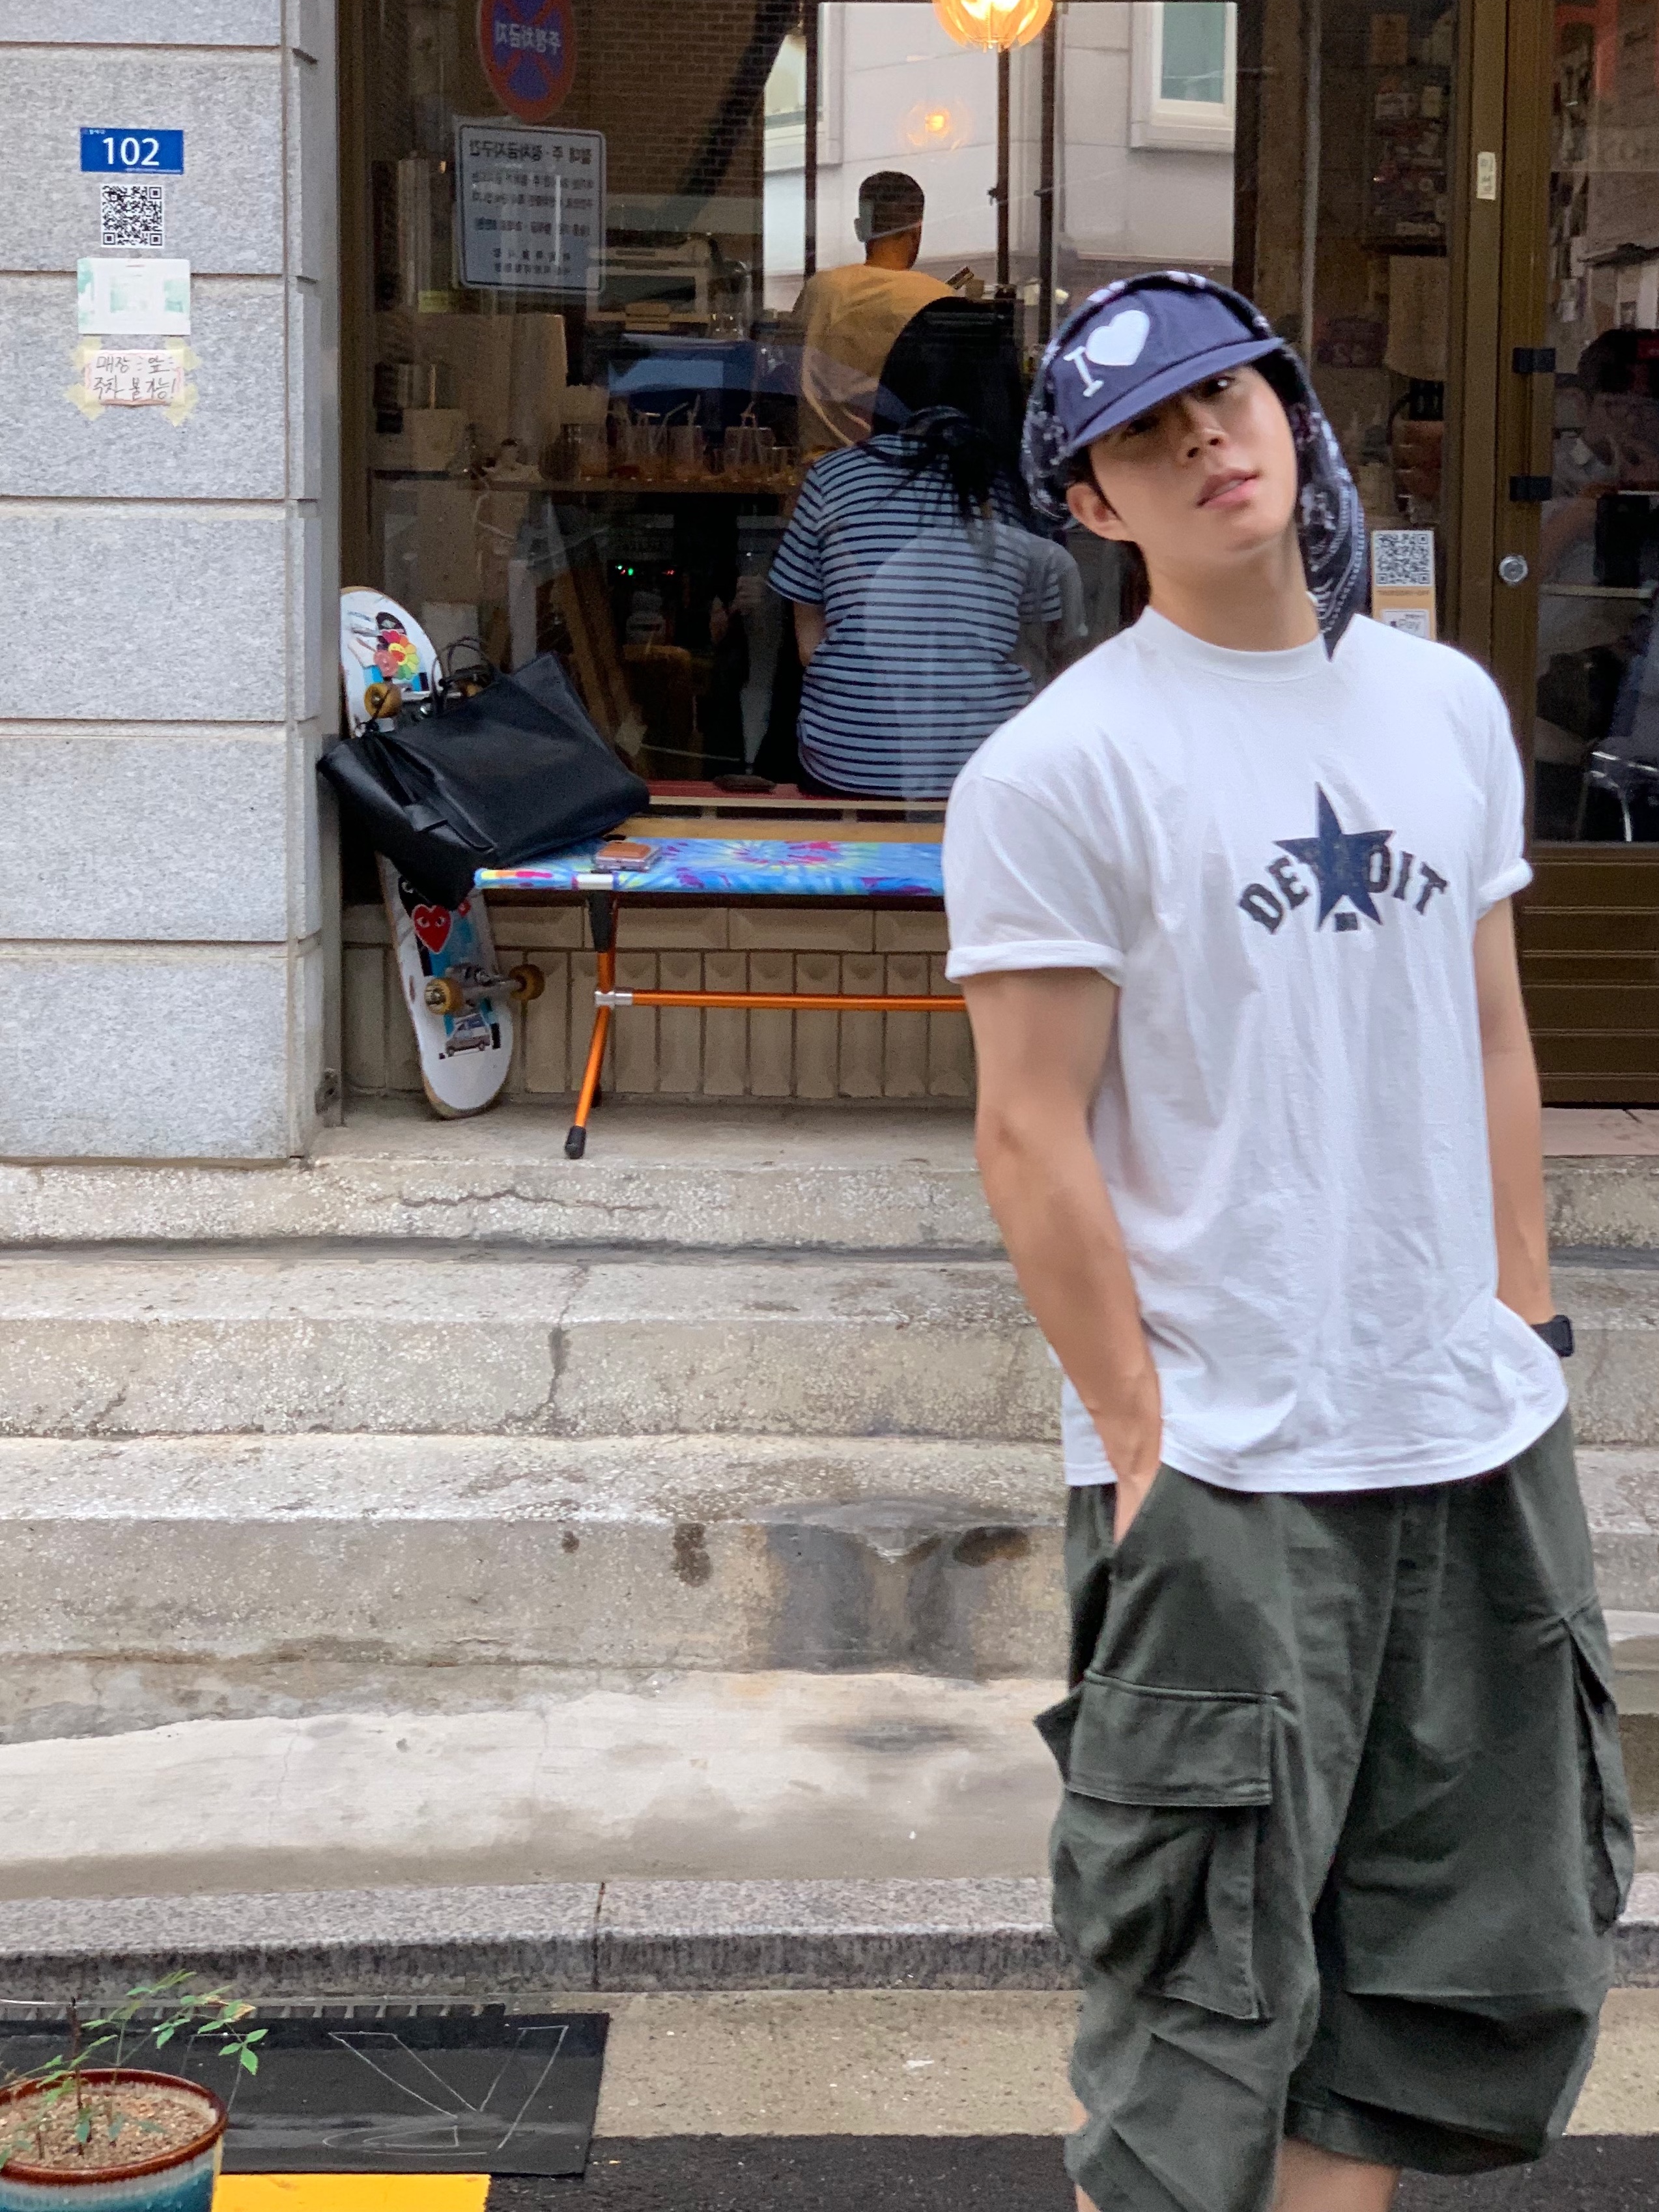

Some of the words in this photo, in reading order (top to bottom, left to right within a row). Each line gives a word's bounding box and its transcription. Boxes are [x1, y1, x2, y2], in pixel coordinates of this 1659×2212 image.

[102, 137, 160, 165] 102
[96, 356, 130, 371] 매장
[147, 356, 170, 374] 앞
[1063, 345, 1104, 397] I
[92, 375, 124, 400] 주차
[1238, 844, 1449, 934] DEOIT
